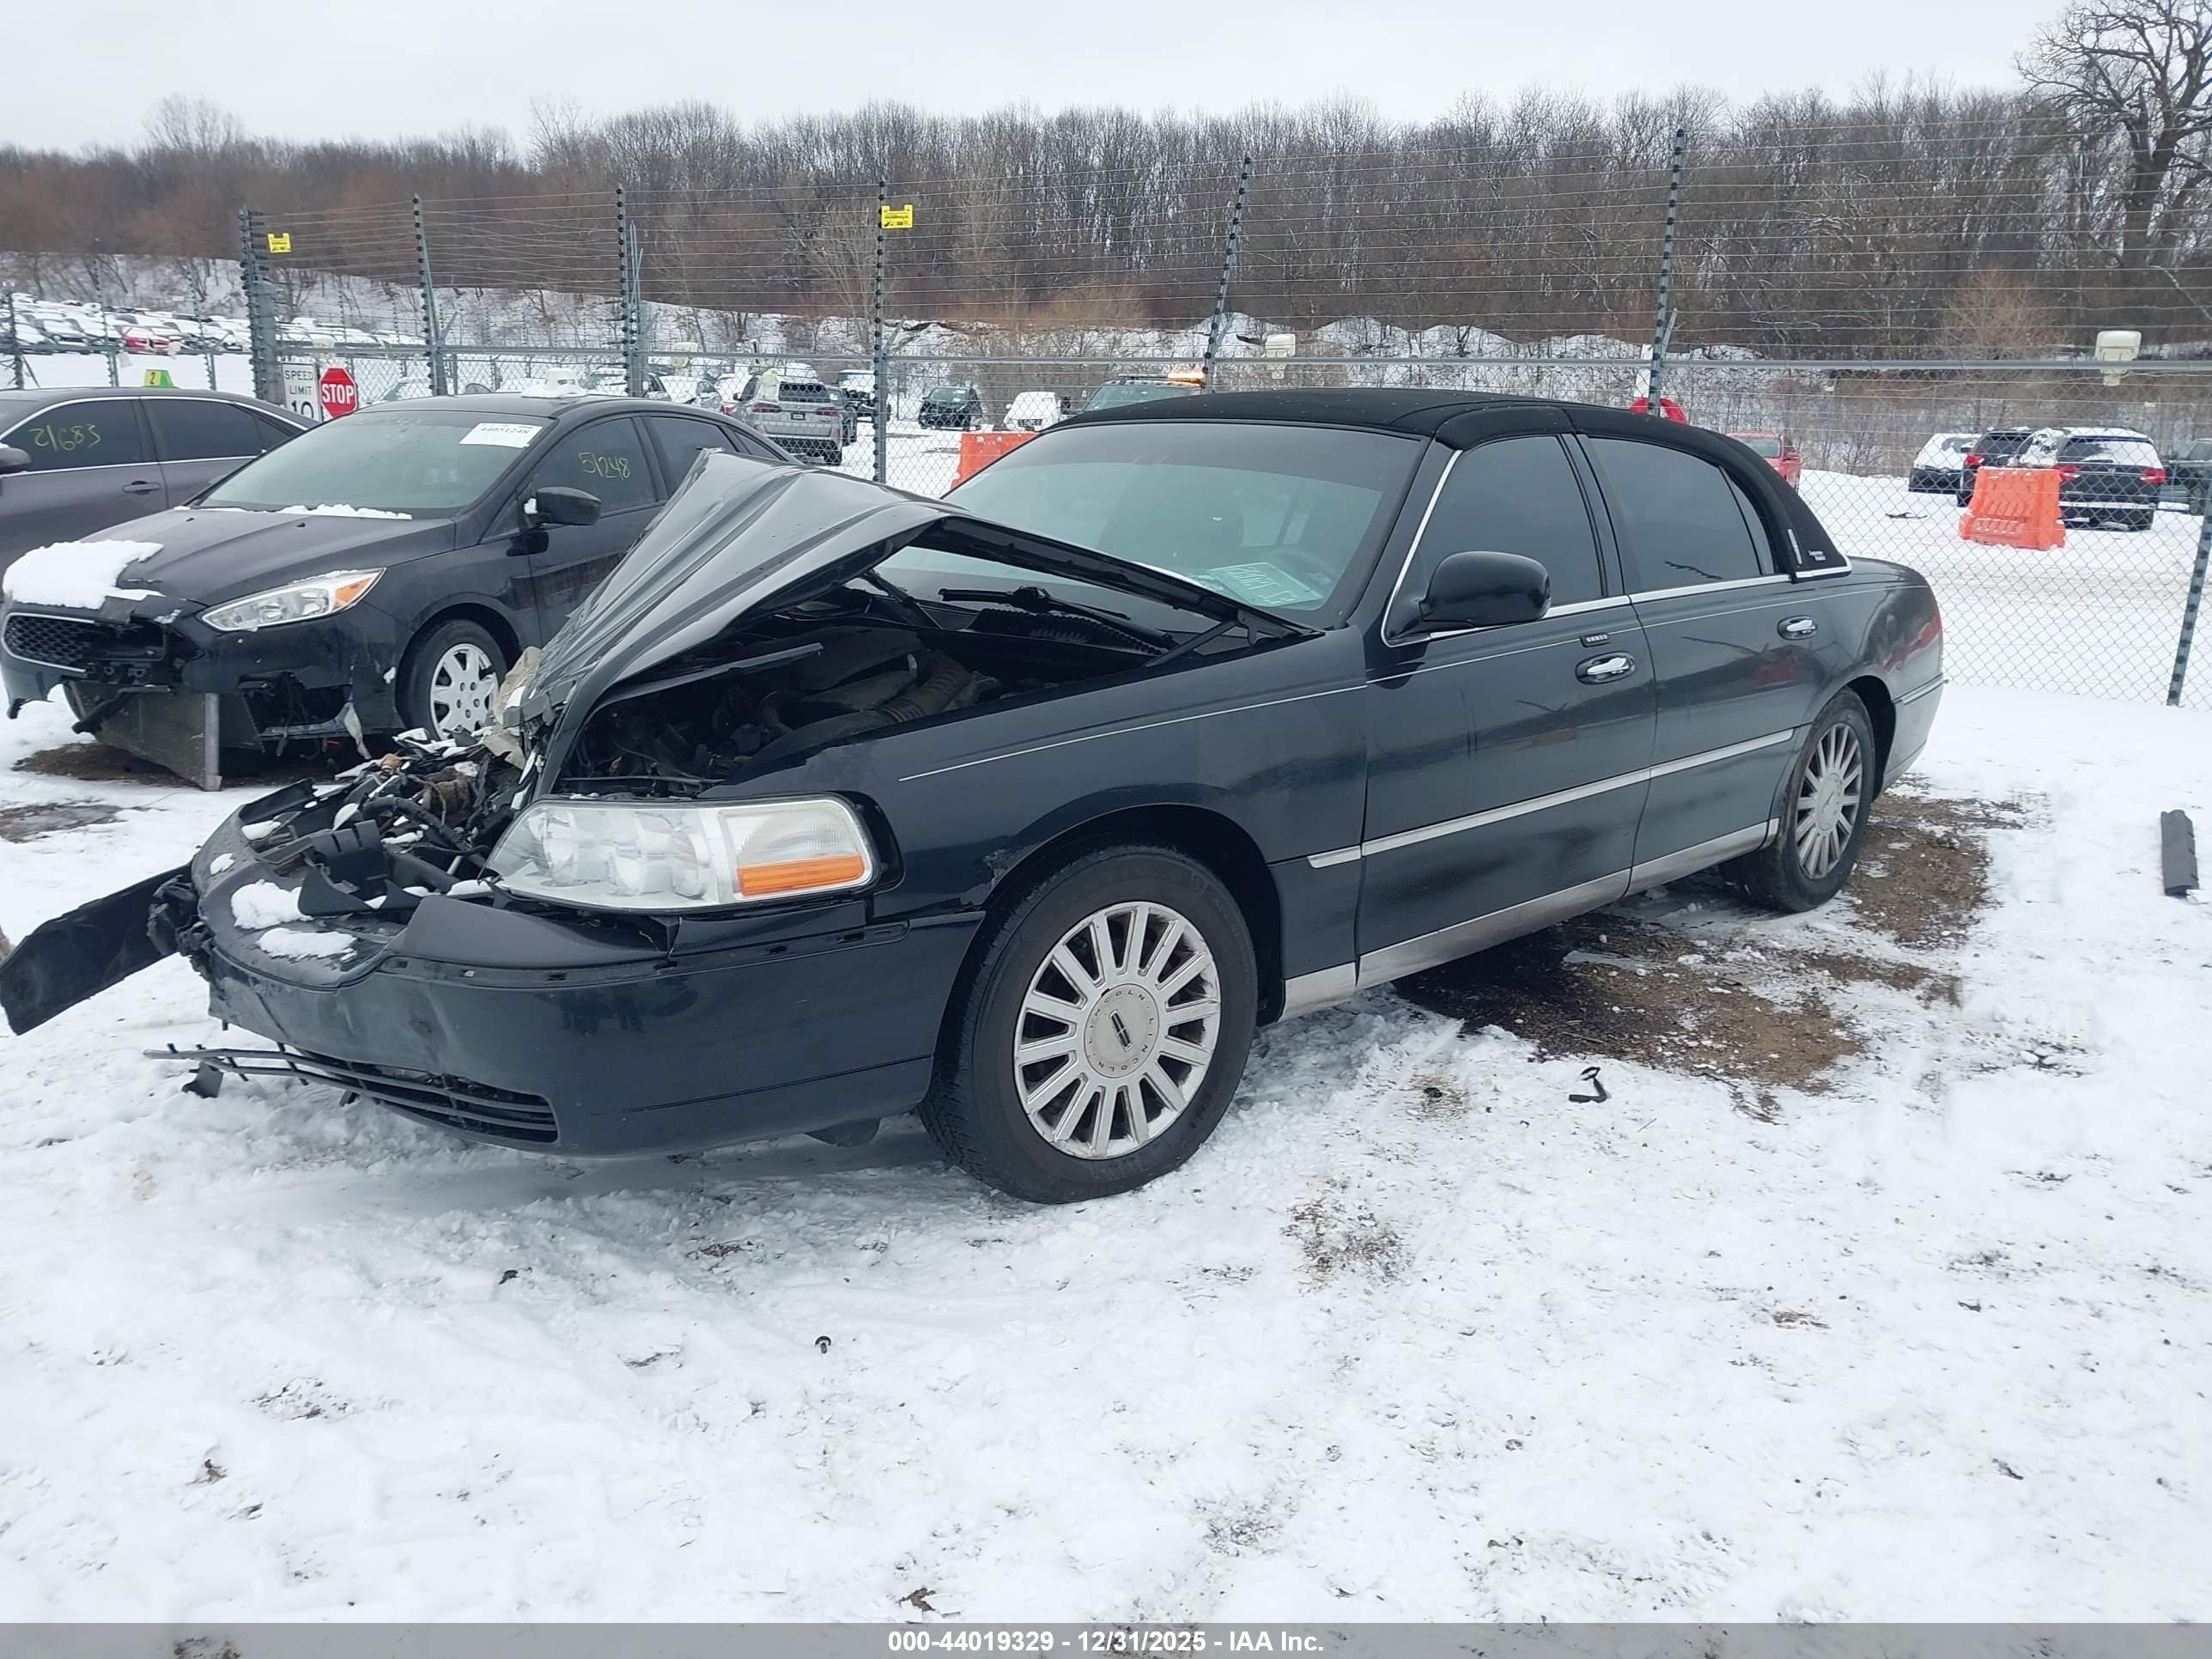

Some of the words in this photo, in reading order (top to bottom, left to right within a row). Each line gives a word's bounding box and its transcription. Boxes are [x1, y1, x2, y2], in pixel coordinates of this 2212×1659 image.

[284, 370, 313, 380] SPEED
[289, 385, 312, 395] LIMIT
[321, 383, 354, 404] STOP
[27, 423, 101, 451] 21683
[578, 452, 631, 481] 51248
[1087, 989, 1146, 1044] LINCOLN
[1097, 1018, 1155, 1073] LINCOLN
